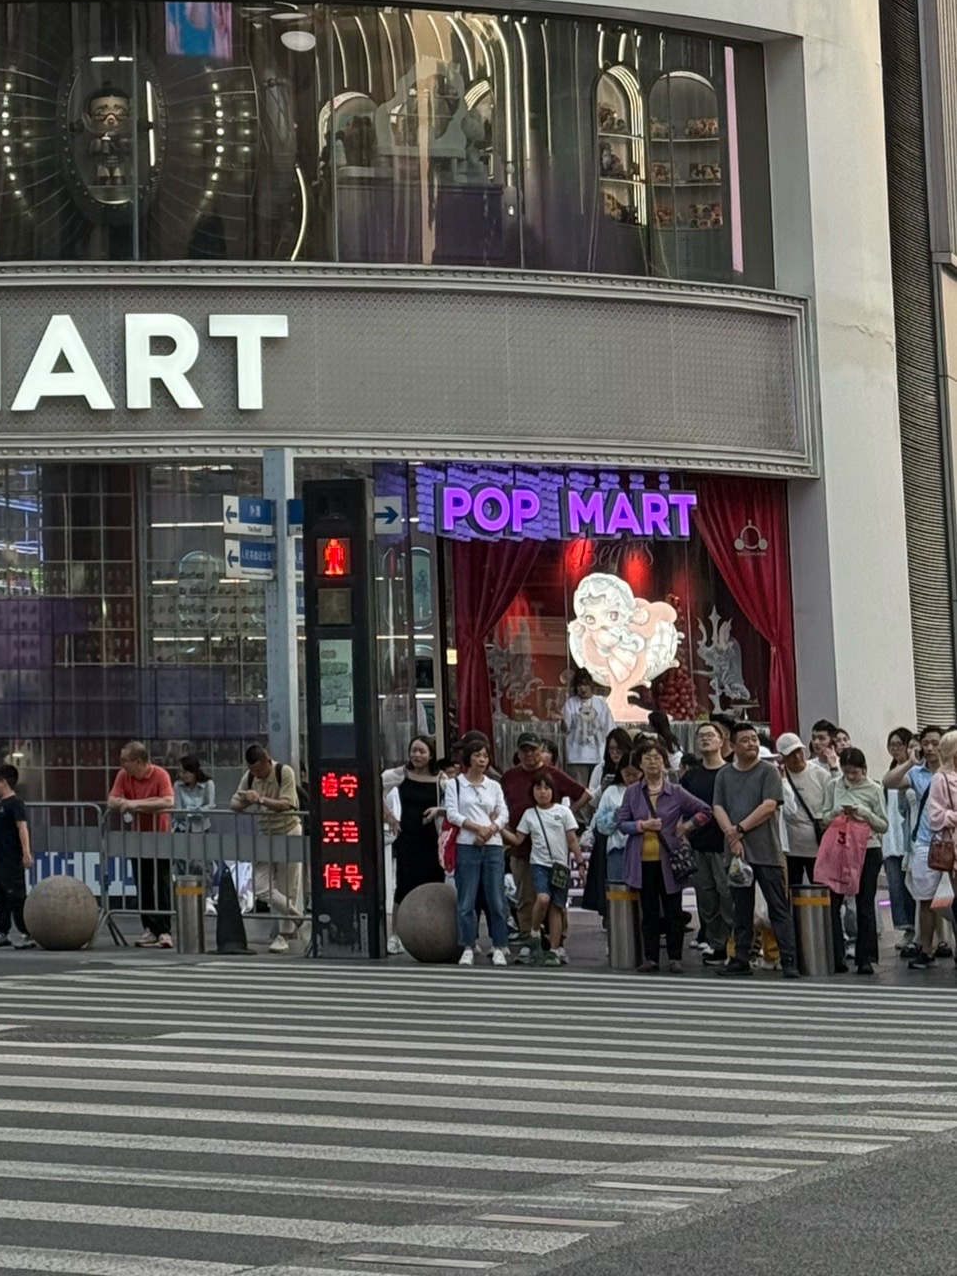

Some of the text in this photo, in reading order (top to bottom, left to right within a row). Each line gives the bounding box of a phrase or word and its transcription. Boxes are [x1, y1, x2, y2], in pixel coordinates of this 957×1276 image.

[440, 486, 697, 537] POP MART
[322, 862, 364, 891] 信号
